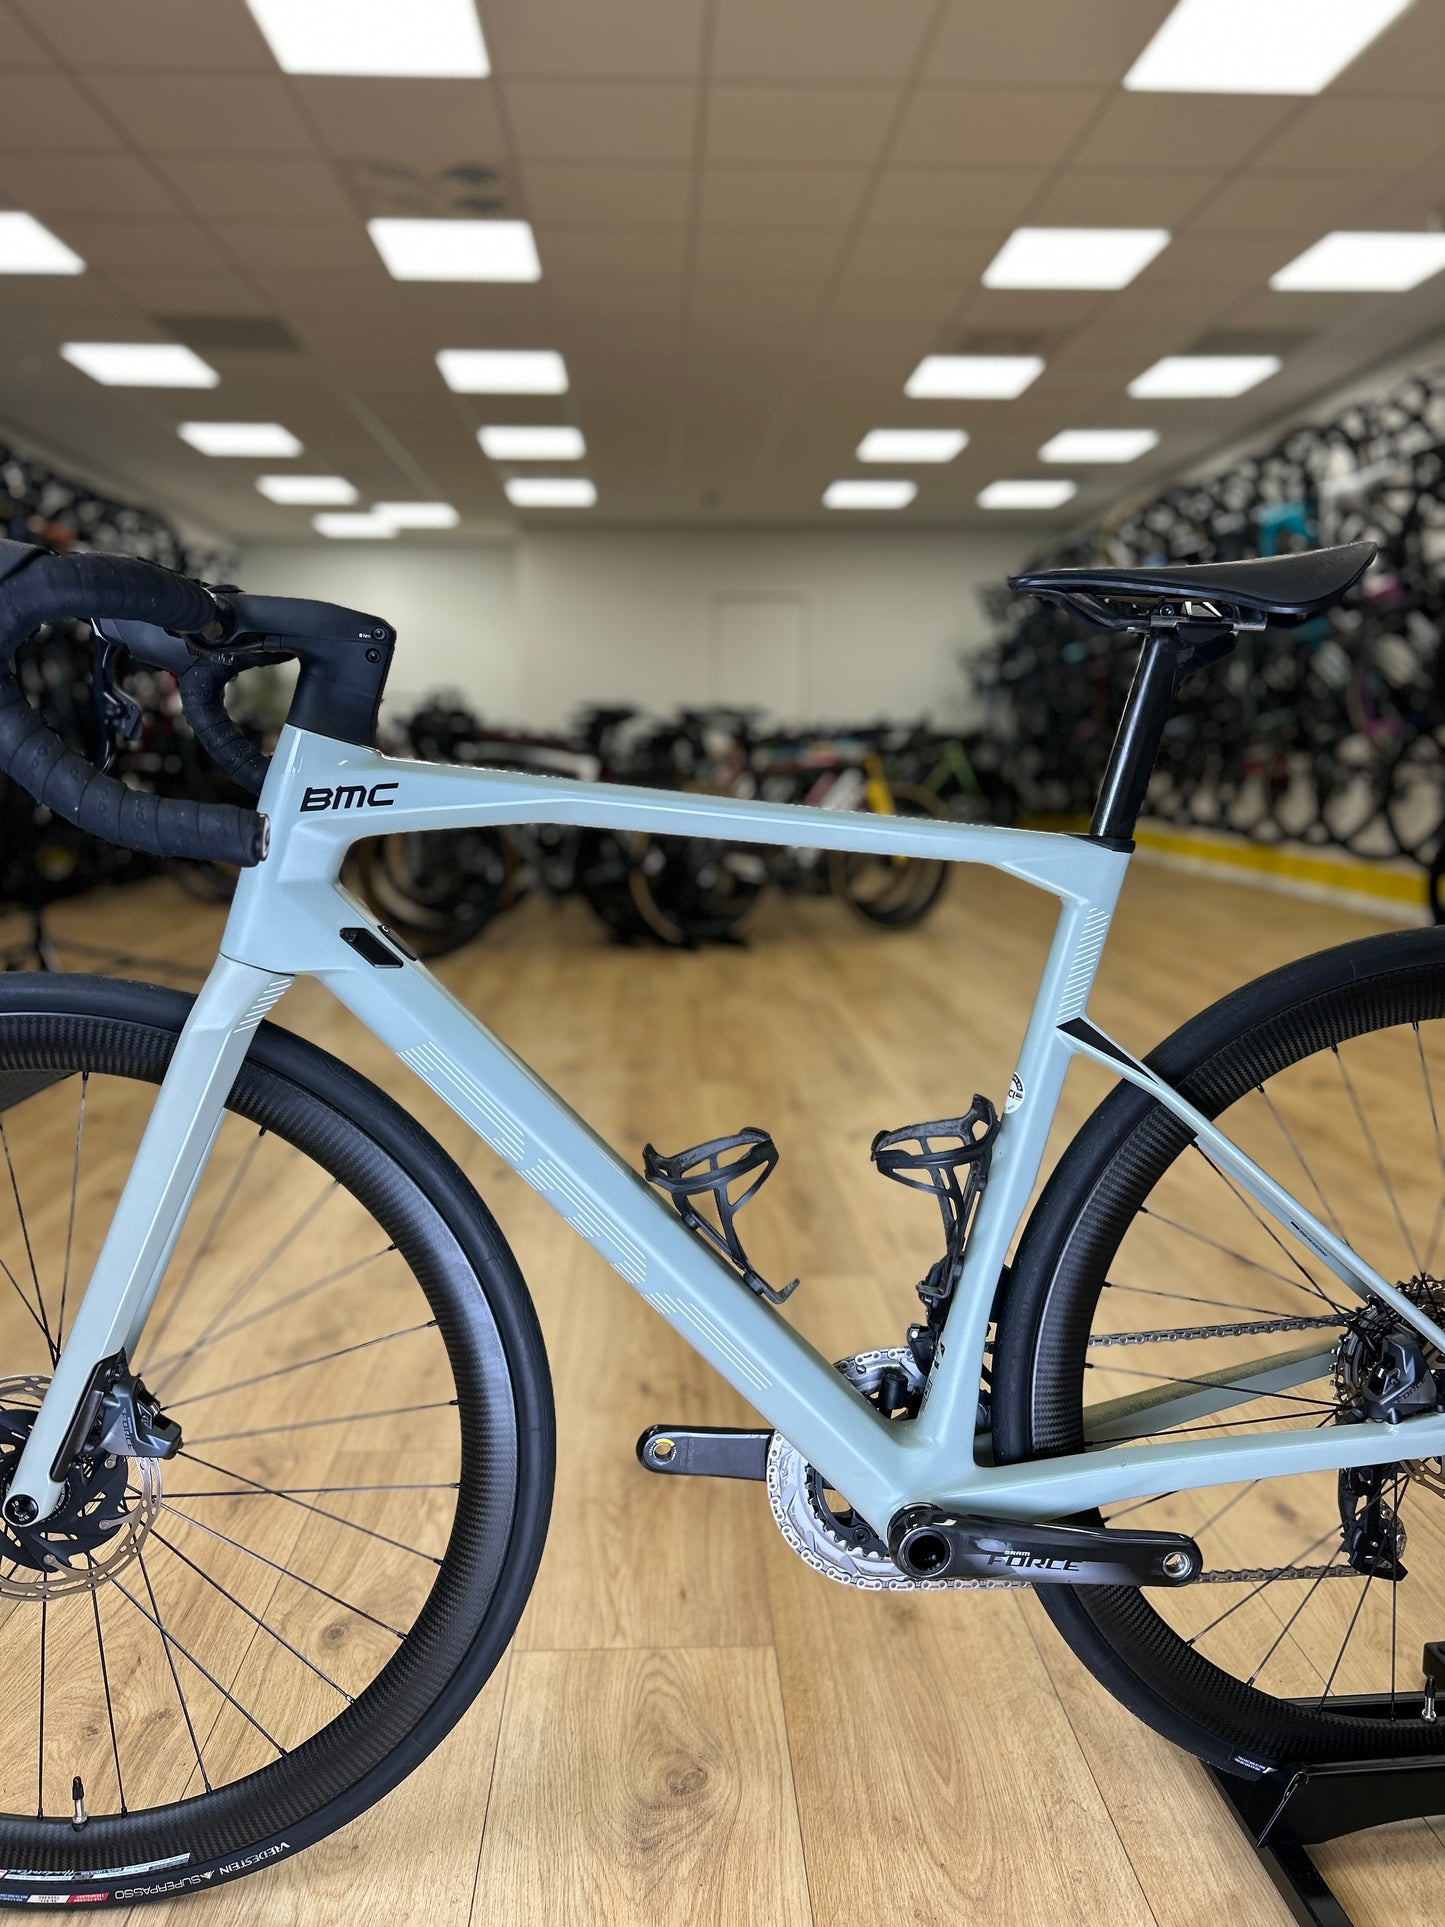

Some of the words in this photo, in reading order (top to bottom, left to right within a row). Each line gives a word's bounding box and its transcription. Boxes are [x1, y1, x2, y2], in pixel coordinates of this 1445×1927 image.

[300, 782, 399, 812] BMC
[986, 1553, 1082, 1572] FORCE
[219, 1841, 291, 1875] VREDESTEIN
[114, 1874, 203, 1900] SUPERPASSO
